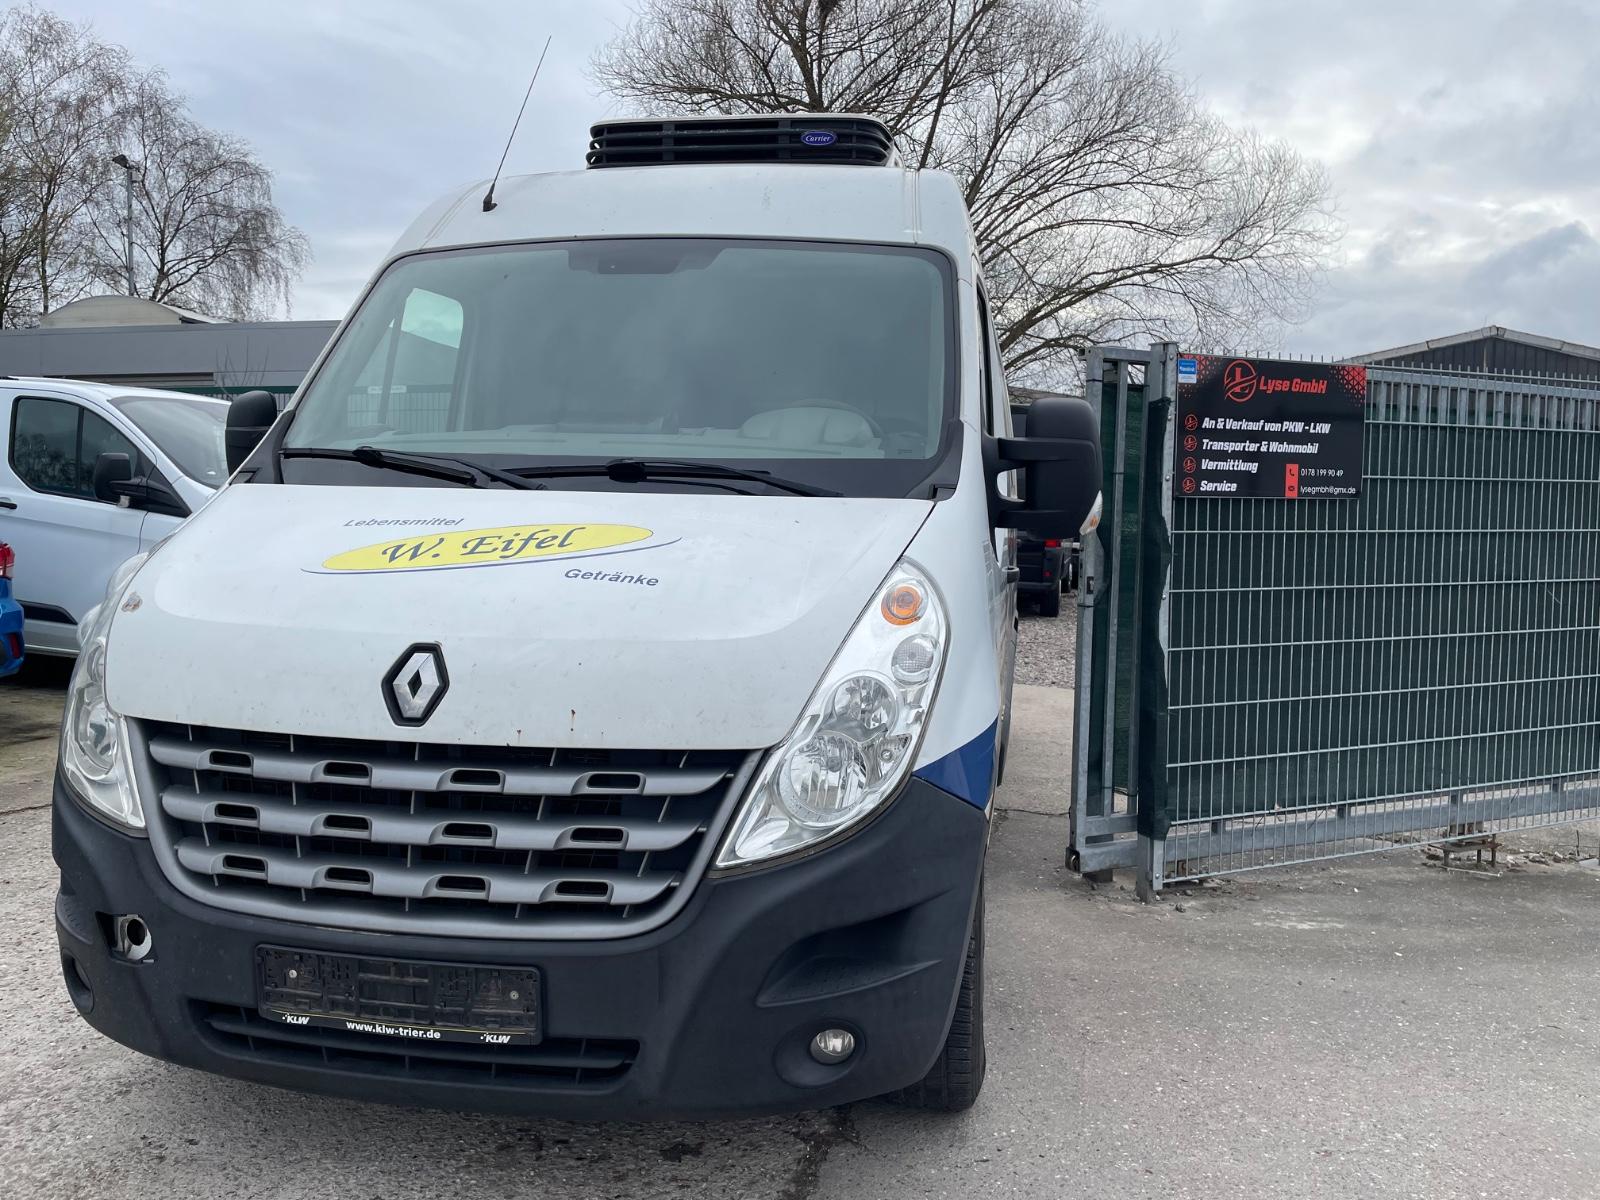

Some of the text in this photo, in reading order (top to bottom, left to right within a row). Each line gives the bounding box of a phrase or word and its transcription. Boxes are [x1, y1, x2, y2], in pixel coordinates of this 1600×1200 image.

[1259, 375, 1327, 394] Lyse GmbH
[1202, 417, 1216, 429] An
[1216, 418, 1225, 429] &
[1225, 418, 1265, 431] Verkauf
[1264, 422, 1282, 432] von
[1282, 421, 1304, 433] PKW
[1309, 422, 1331, 434] LKW
[1202, 439, 1319, 454] Transporter & Wohnmobil
[1201, 459, 1259, 473] Vermittlung
[1300, 468, 1344, 477] 0178 199 90 49
[1200, 480, 1238, 492] Service
[1300, 485, 1356, 495] lysegmbh@gmx.de
[343, 517, 464, 527] Lebensmittel
[381, 527, 586, 563] W. Eifel
[564, 568, 659, 587] Getränke
[286, 1015, 310, 1025] KLW
[346, 1021, 441, 1040] www.klw-trier.de
[485, 1034, 511, 1044] KLW
